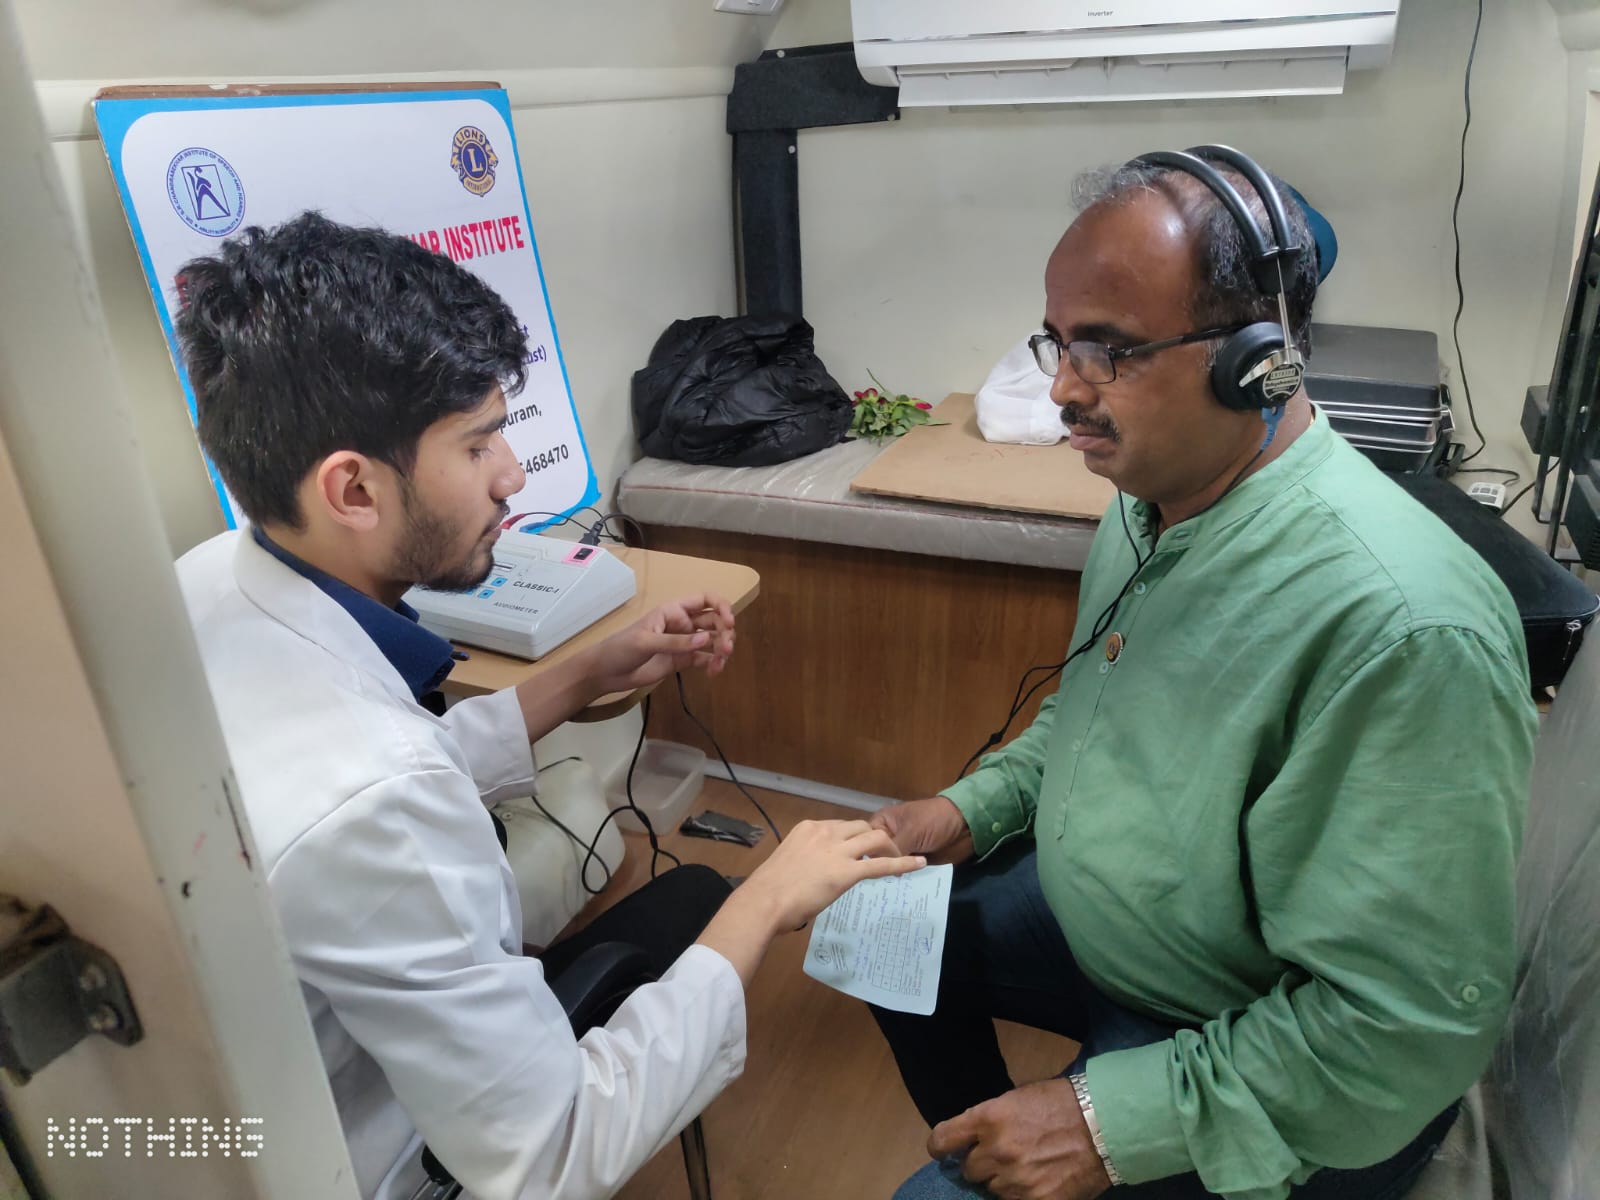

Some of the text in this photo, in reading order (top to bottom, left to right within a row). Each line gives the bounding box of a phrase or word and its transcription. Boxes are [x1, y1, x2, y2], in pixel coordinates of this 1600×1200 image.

[455, 128, 484, 145] LIONS
[467, 148, 483, 172] L
[443, 216, 524, 262] INSTITUTE
[522, 344, 547, 364] ust)
[500, 404, 542, 434] puram,
[519, 444, 569, 474] 468470
[493, 601, 539, 614] AUDIOMETER
